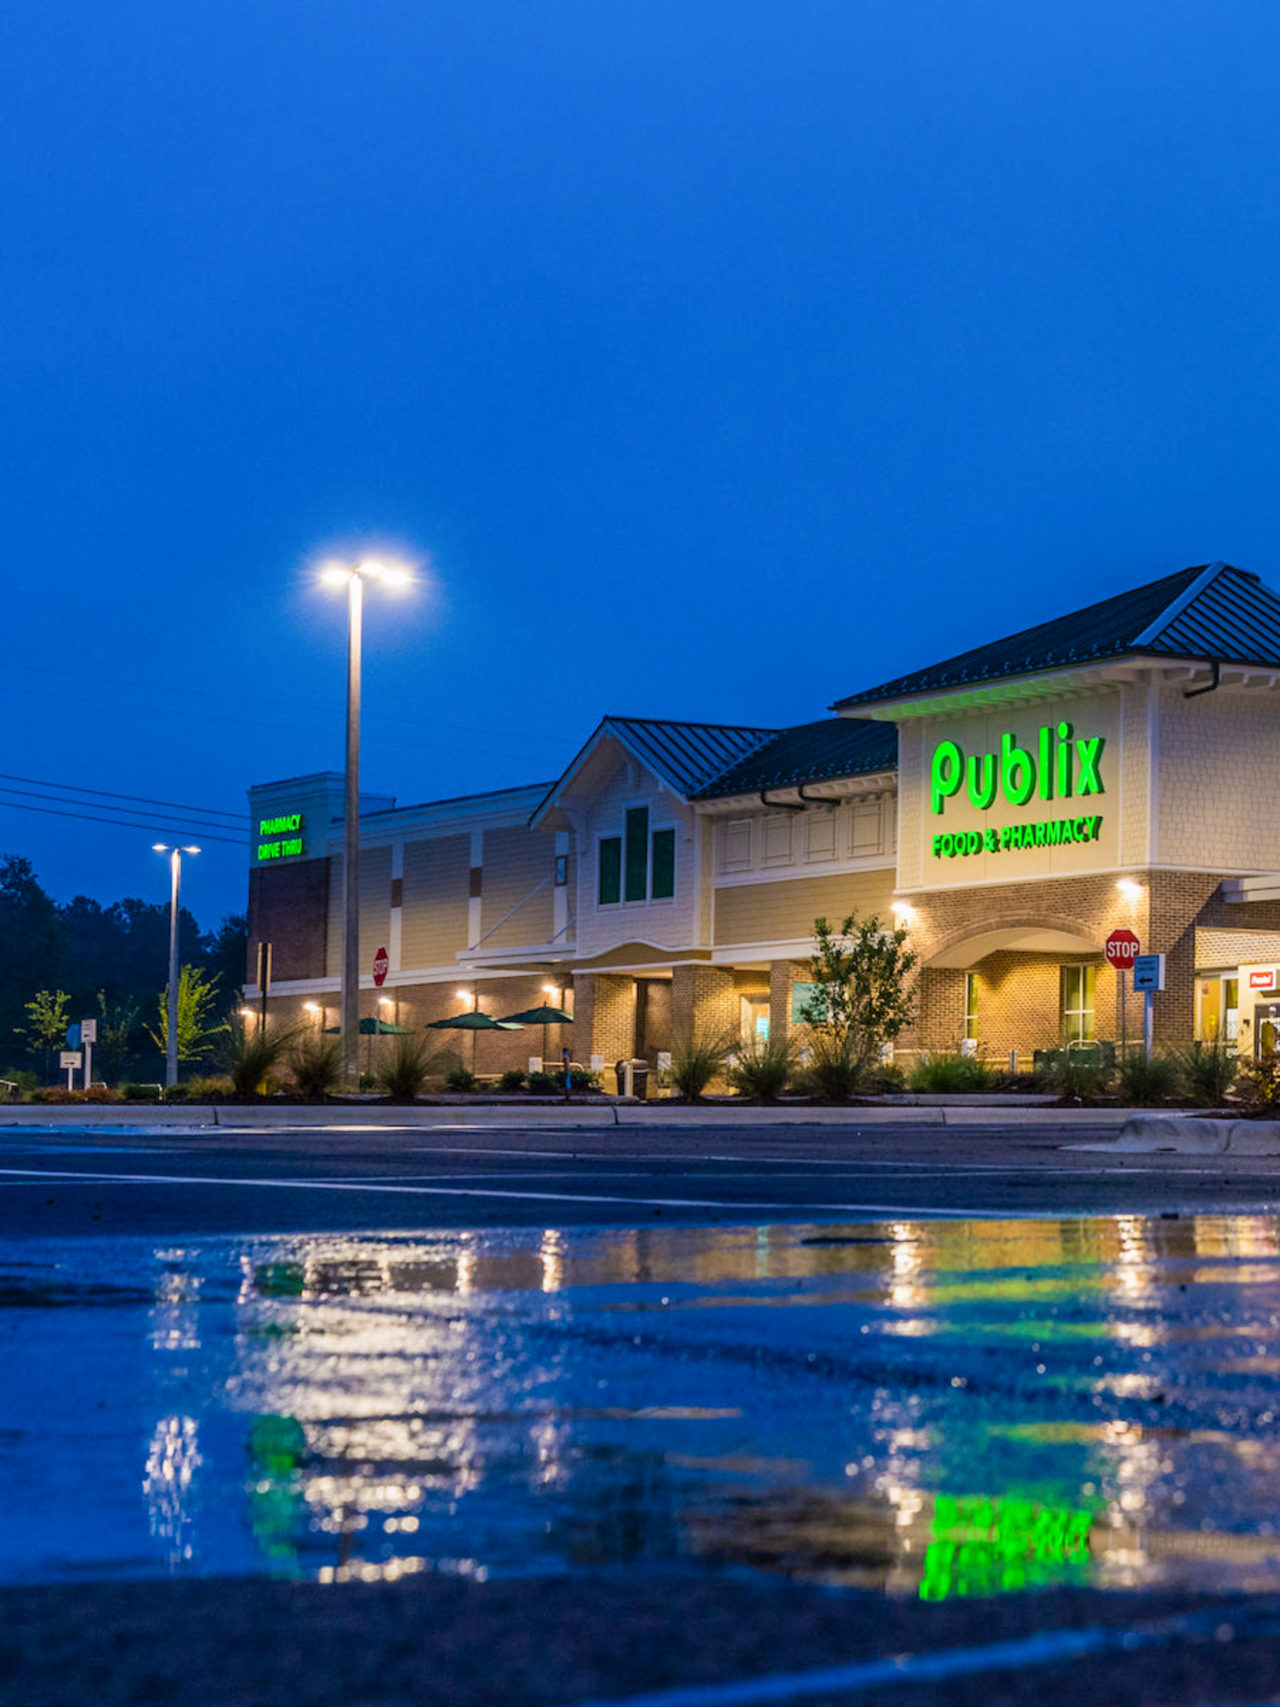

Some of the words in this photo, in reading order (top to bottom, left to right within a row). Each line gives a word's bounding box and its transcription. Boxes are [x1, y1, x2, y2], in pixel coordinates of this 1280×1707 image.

[931, 721, 1105, 814] Publix
[260, 814, 302, 836] PHARMACY
[932, 830, 982, 858] FOOD
[983, 828, 1000, 852] &
[1001, 815, 1103, 850] PHARMACY
[257, 842, 280, 861] DRIVE
[281, 838, 303, 857] THRU
[1107, 941, 1139, 958] STOP
